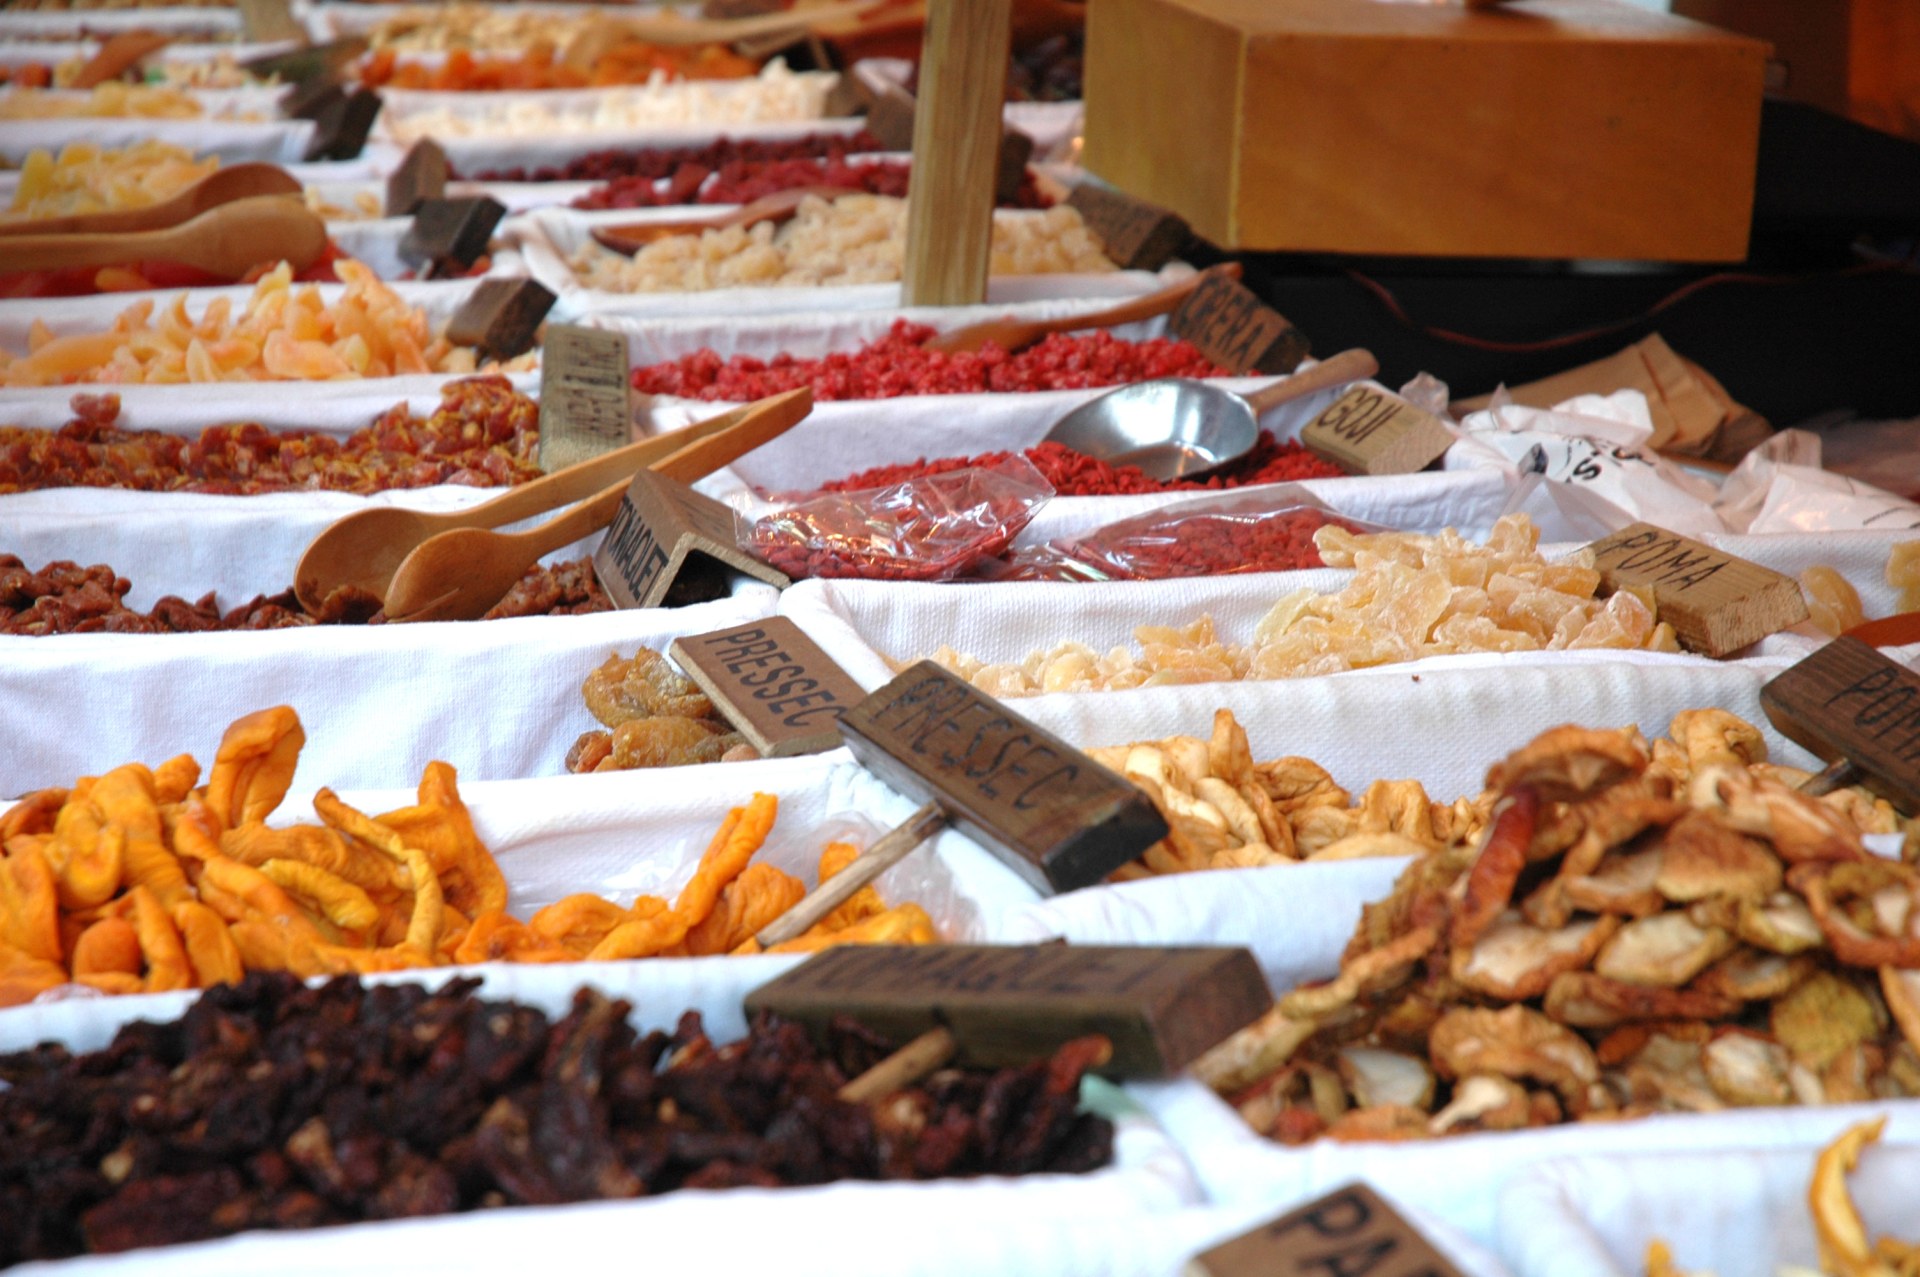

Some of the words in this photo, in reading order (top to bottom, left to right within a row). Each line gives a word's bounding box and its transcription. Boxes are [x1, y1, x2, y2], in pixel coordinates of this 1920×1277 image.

[1317, 387, 1404, 446] GOJI
[1596, 531, 1732, 592] POMA
[704, 628, 848, 727] PRESSEC
[1824, 666, 1920, 762] POM
[868, 676, 1080, 810] PRESSEC
